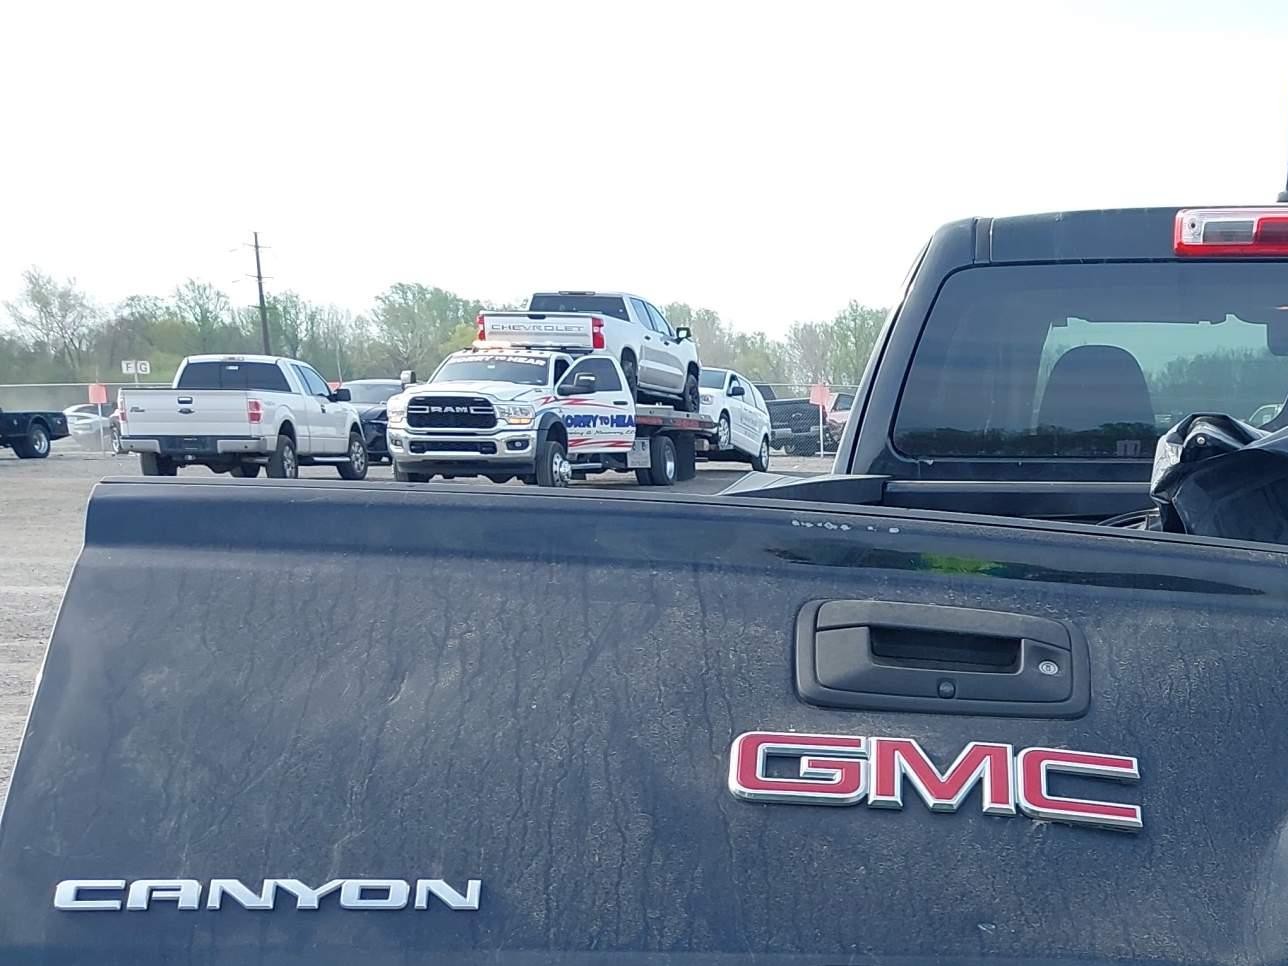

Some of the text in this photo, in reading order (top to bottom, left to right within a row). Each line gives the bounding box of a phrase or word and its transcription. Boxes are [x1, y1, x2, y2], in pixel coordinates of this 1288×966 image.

[491, 324, 584, 332] CHEVROLET
[599, 415, 610, 426] TO
[728, 731, 1143, 833] GMC
[54, 878, 482, 911] CANYON
